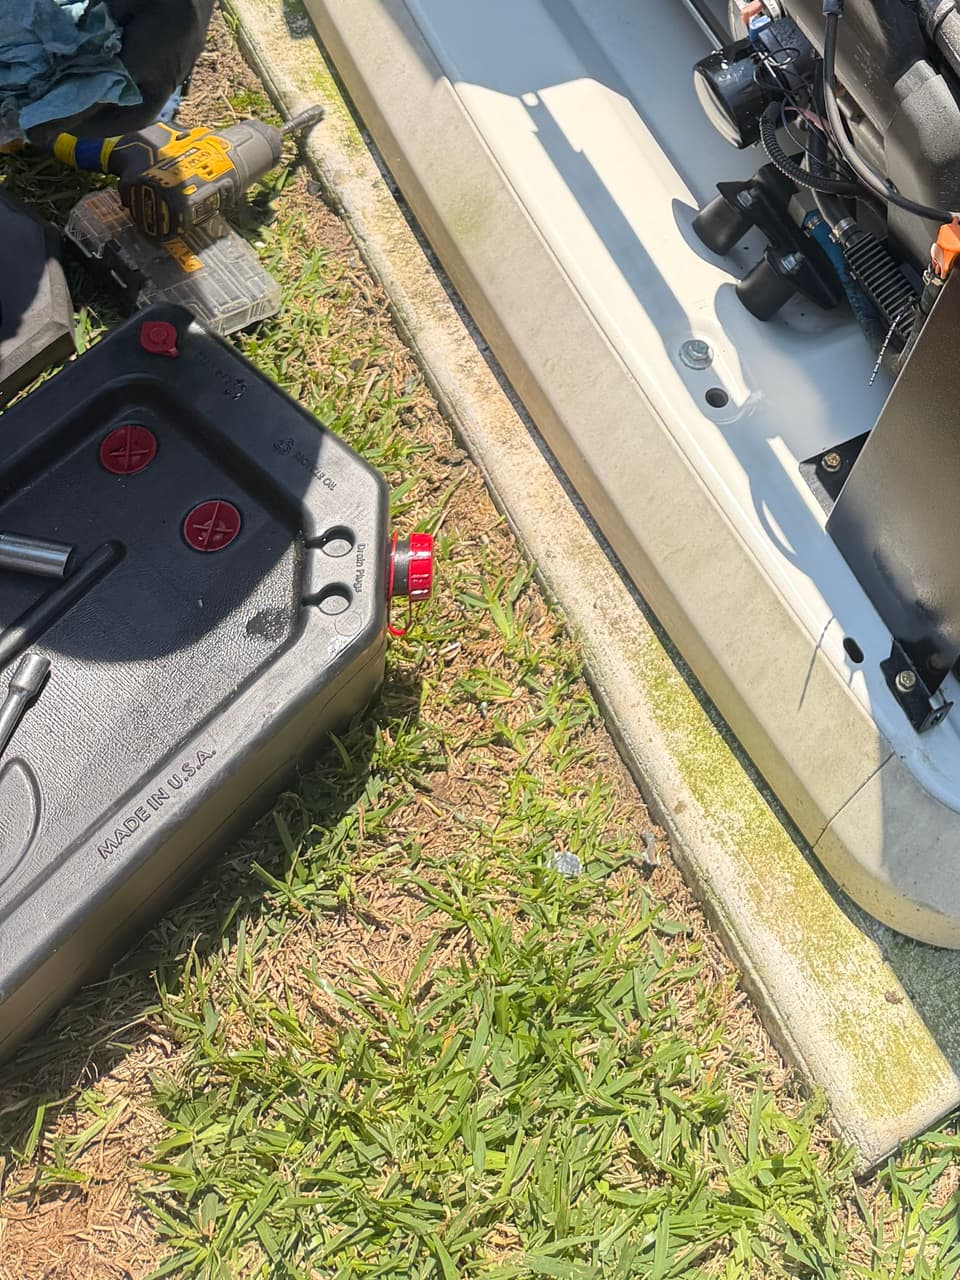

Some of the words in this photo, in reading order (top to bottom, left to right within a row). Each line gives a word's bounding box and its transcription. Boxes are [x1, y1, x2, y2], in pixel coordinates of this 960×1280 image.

[354, 543, 366, 567] Drain
[352, 569, 365, 592] Plugs
[97, 807, 151, 860] MADE
[146, 789, 170, 811] IN
[168, 749, 217, 790] U.S.A.
